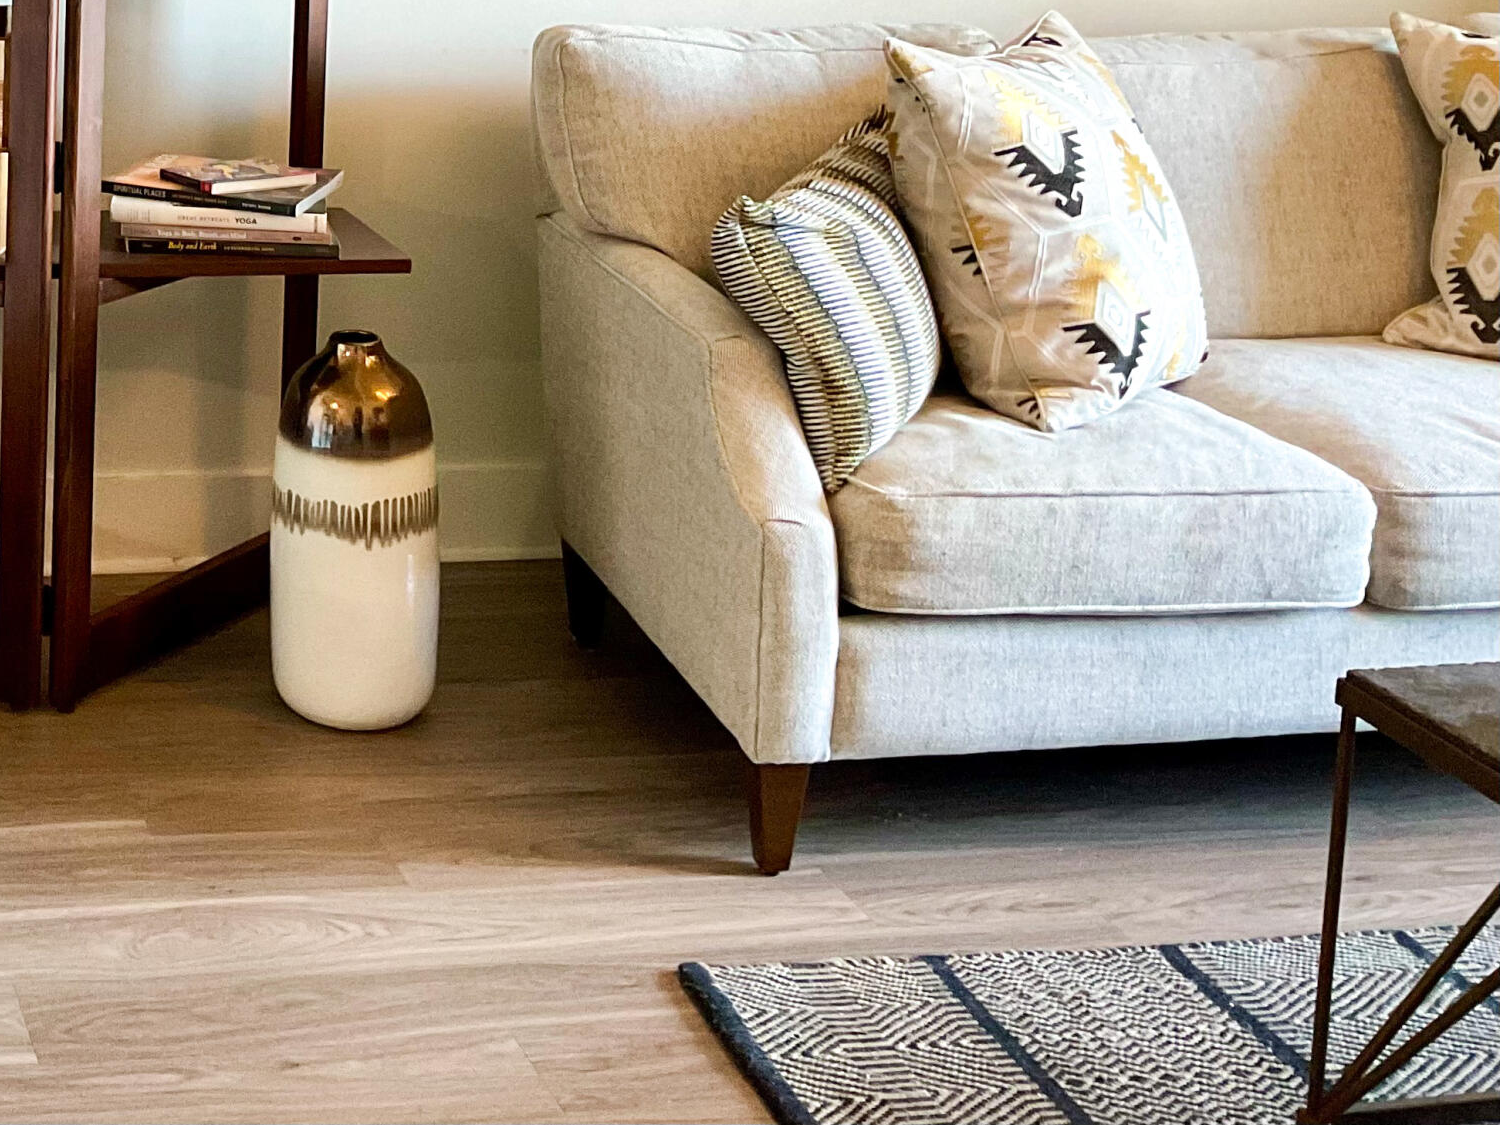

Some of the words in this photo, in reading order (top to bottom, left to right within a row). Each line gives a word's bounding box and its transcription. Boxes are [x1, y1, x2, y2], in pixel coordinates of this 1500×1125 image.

[113, 184, 142, 195] SPIRITUAL
[143, 188, 166, 198] PLACES
[168, 241, 183, 250] Body
[185, 242, 198, 250] and
[199, 242, 217, 250] Earth
